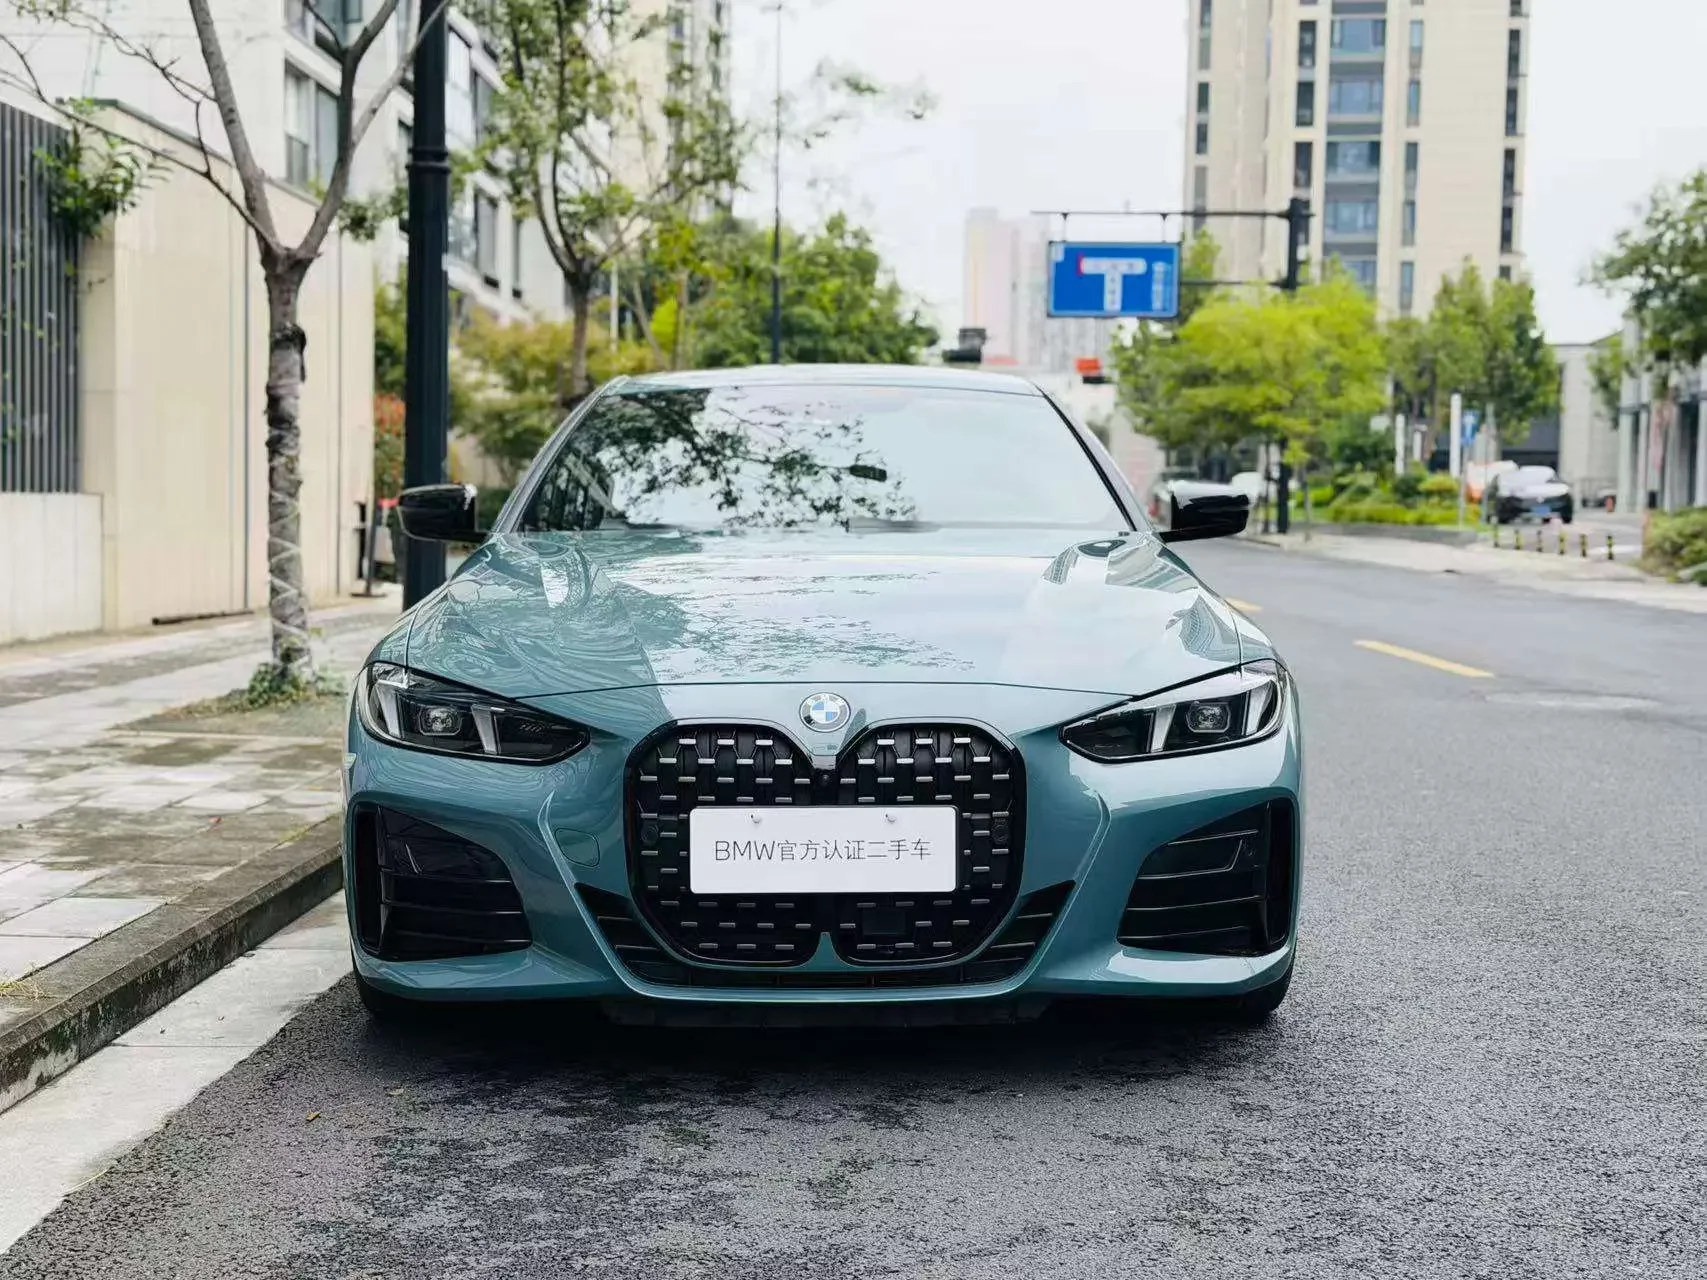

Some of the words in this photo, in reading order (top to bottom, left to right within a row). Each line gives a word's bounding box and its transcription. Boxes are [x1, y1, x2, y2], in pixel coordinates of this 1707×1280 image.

[715, 838, 931, 861] BMW官方认证二手车
